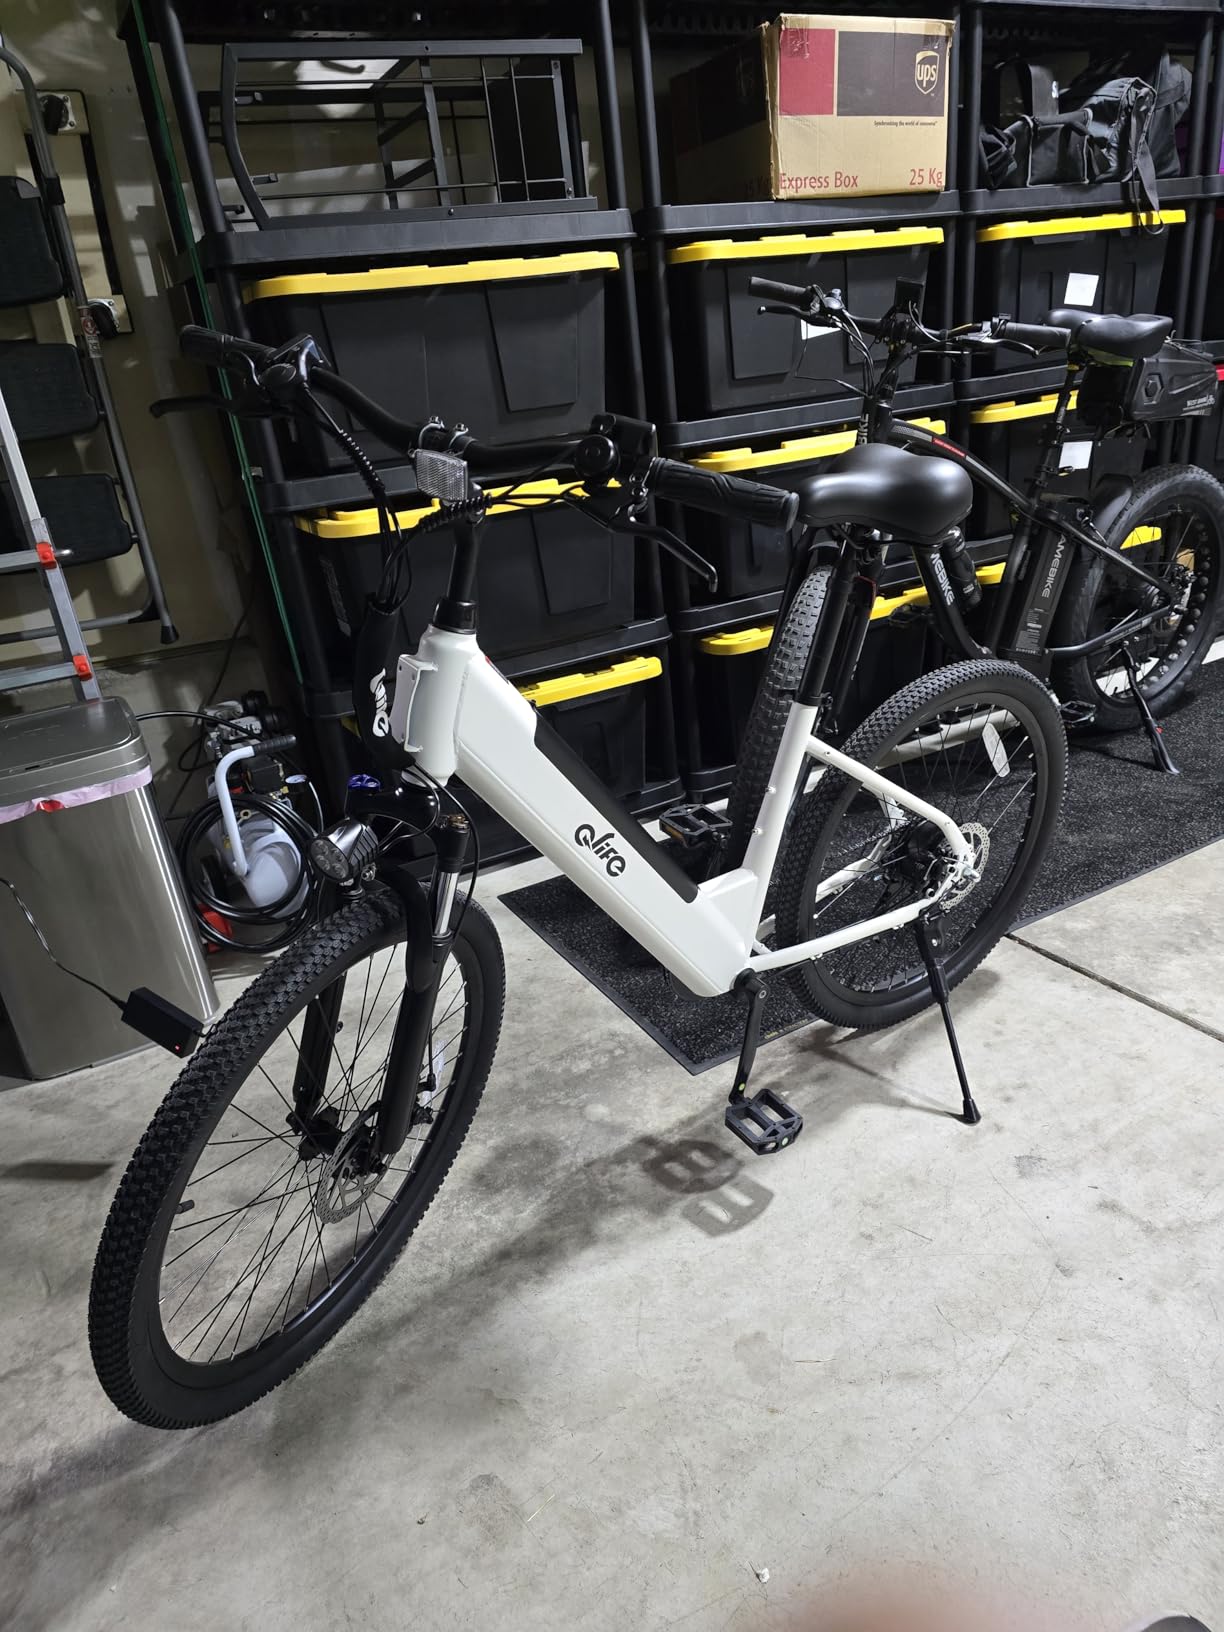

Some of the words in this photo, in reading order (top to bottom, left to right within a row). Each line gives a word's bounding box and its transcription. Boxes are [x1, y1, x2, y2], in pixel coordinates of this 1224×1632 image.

[917, 64, 937, 87] ups
[874, 120, 898, 128] Synchng
[779, 172, 830, 193] Express
[834, 171, 859, 188] Box
[909, 168, 925, 186] 25
[928, 167, 943, 188] Kg
[1041, 533, 1066, 598] AMEBIKE
